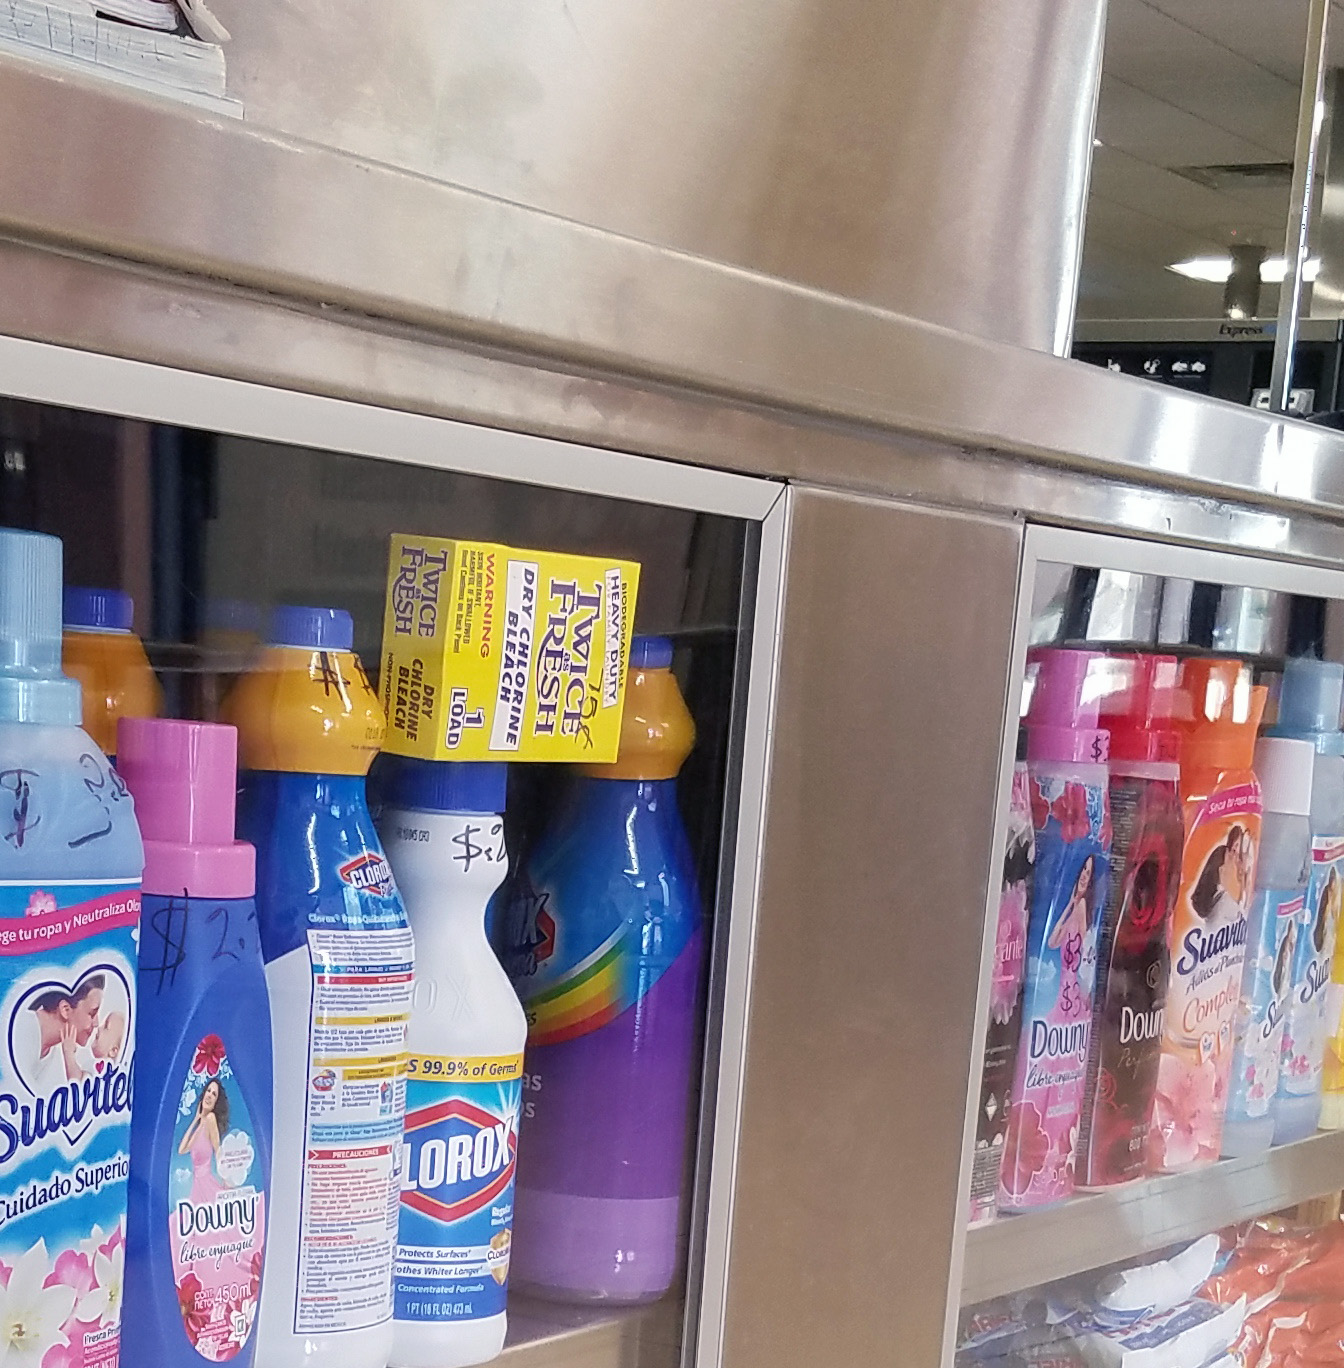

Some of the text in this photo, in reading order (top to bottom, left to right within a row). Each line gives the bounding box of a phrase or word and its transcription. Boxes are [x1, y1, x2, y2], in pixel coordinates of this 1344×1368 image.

[391, 545, 425, 636] FRESH
[418, 550, 449, 637] TWICE
[480, 553, 496, 660] WARNING
[499, 610, 519, 705] BLEACH
[506, 568, 536, 746] DRY CHLORINE
[535, 578, 578, 736] FRESH
[560, 583, 603, 736] TWICE
[607, 575, 621, 701] HEAVY DUTY
[394, 665, 410, 730] BLEACH
[406, 658, 424, 742] CHLORINE
[421, 683, 435, 720] DRY
[446, 690, 466, 747] LOAD
[464, 708, 484, 726] 1
[18, 928, 32, 941] tu
[33, 921, 63, 942] ropa
[64, 919, 72, 933] y
[73, 903, 126, 928] Neutraliza
[1029, 1019, 1090, 1063] Downy
[422, 1058, 469, 1078] 99.9%
[472, 1060, 488, 1076] of
[1026, 1063, 1054, 1090] libre
[74, 1155, 129, 1195] Superio
[400, 1115, 516, 1194] LOROX
[178, 1195, 258, 1237] Downy
[180, 1240, 208, 1264] libre
[396, 1265, 453, 1276] othes Whiter
[398, 1247, 434, 1259] Protects
[397, 1282, 485, 1294] Concentrated Formula
[411, 1302, 420, 1314] PT
